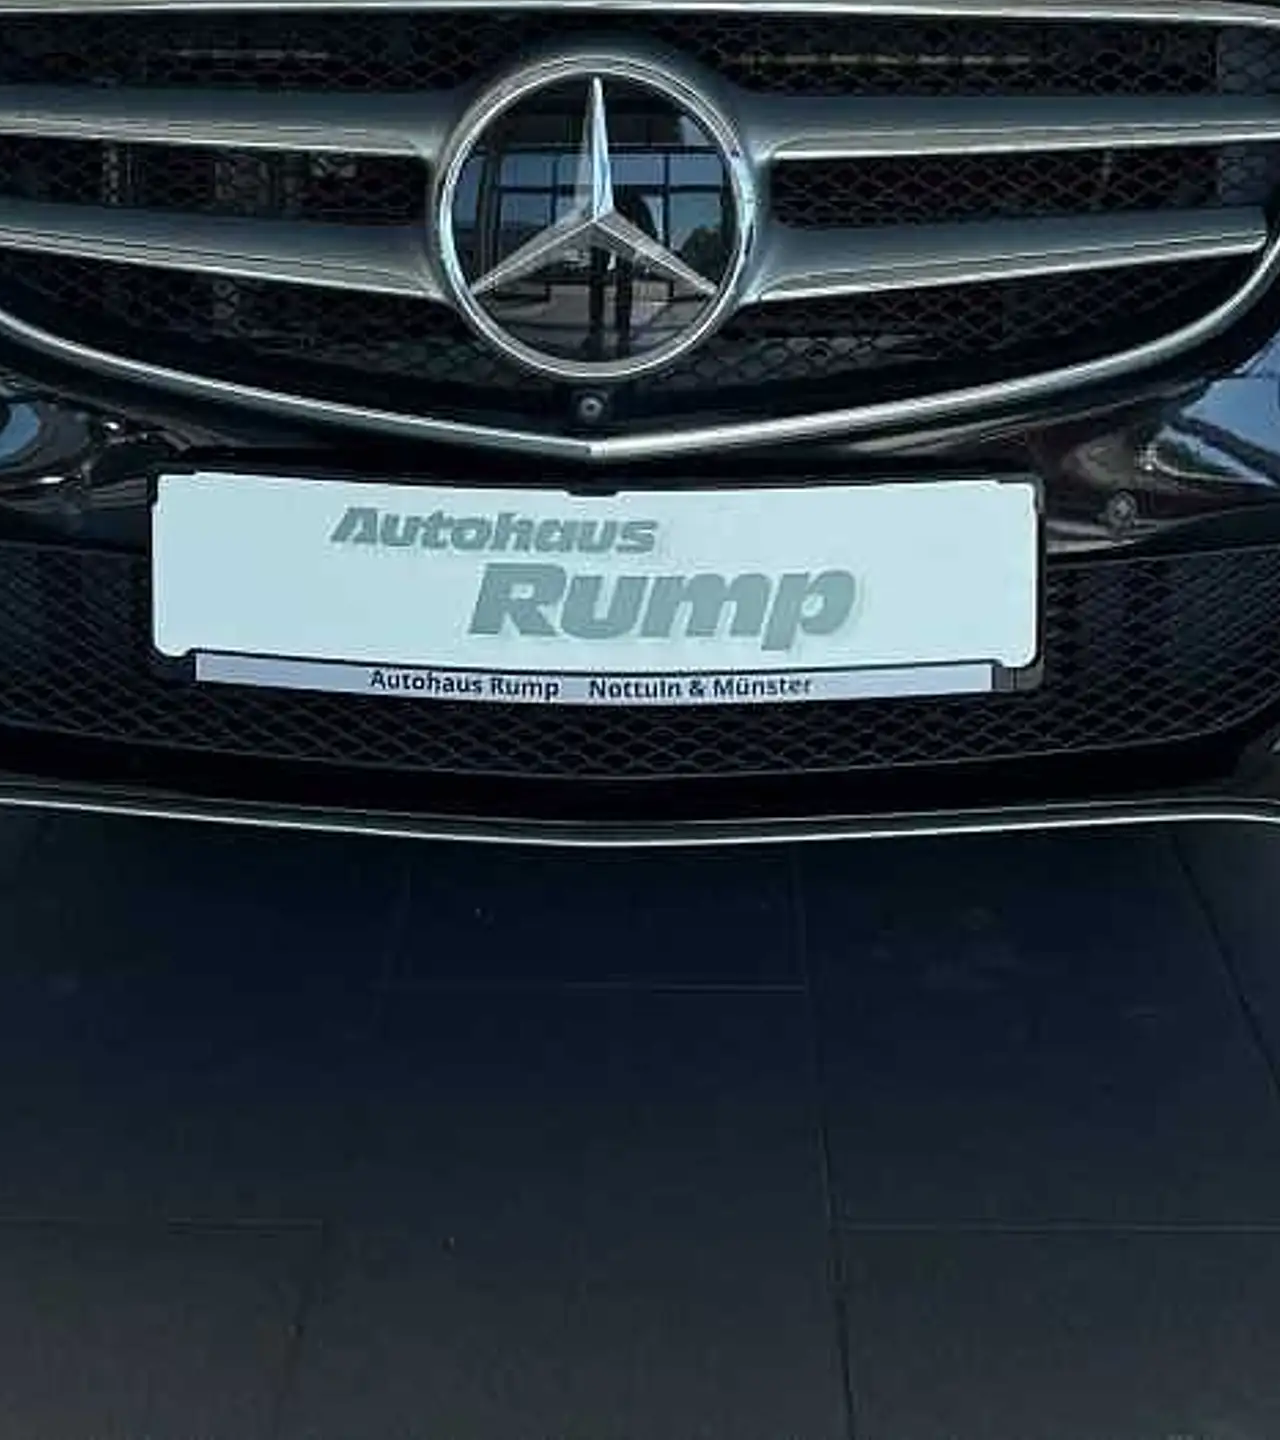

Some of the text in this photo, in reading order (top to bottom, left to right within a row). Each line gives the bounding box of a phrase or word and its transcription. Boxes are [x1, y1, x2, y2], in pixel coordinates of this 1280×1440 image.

[330, 506, 659, 553] Autohaus
[467, 562, 856, 652] Rump
[370, 669, 812, 701] Autohaus Rump Nottuln & Münster
